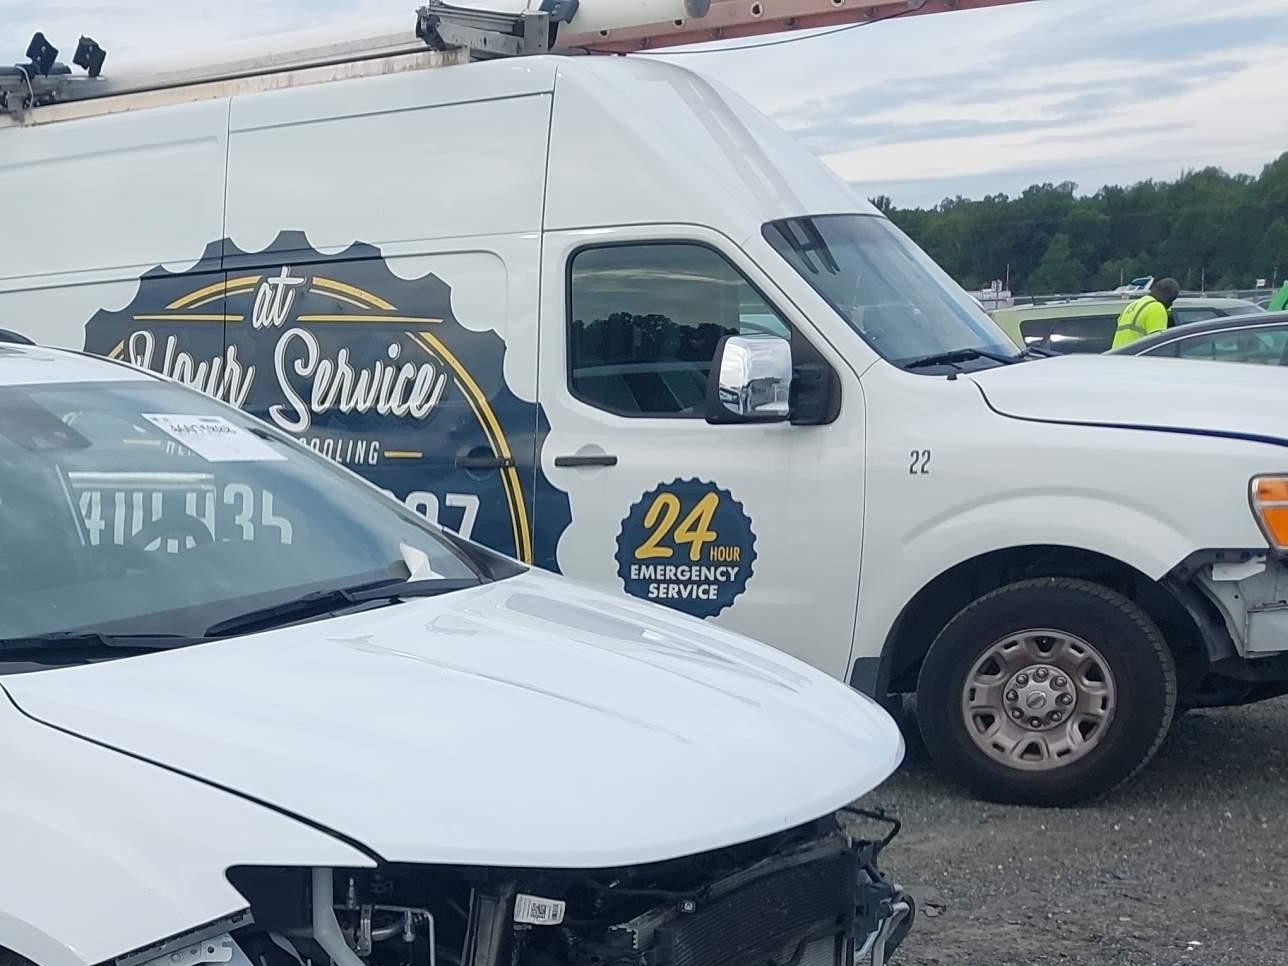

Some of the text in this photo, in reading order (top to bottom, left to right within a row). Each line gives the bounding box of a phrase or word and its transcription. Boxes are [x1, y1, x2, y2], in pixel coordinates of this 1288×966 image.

[252, 265, 306, 329] at
[269, 327, 447, 432] Service
[909, 450, 931, 475] 22
[634, 491, 740, 562] 24 HOUR
[630, 564, 739, 582] EMERGENCY
[648, 583, 718, 600] SERVICE
